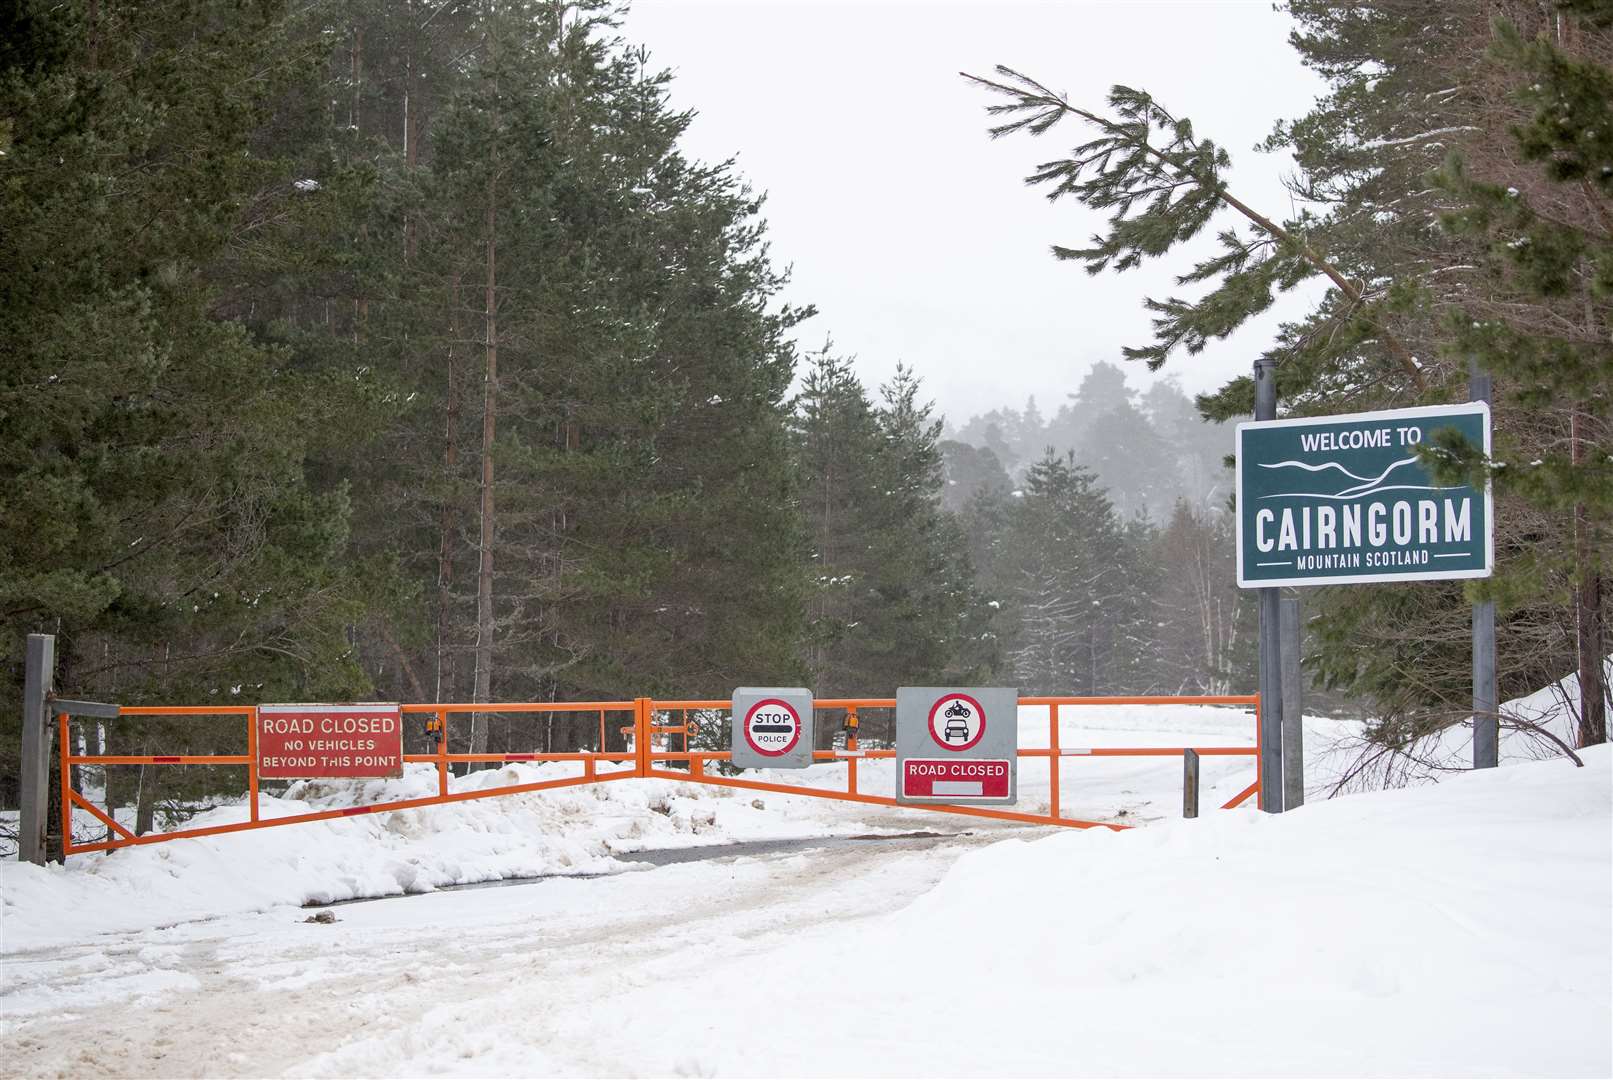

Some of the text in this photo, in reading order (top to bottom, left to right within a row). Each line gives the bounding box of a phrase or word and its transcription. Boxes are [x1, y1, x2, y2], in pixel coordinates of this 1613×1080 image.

[1300, 426, 1422, 452] WELCOME TO
[1256, 497, 1471, 553] CAIRNGORM
[1297, 550, 1429, 571] MOUNTAIN SCOTLAND
[755, 713, 791, 724] STOP
[263, 718, 395, 734] ROAD CLOSED
[284, 739, 375, 751] NO VEHICLES
[758, 735, 787, 743] POLICE
[263, 756, 397, 767] BEYOND THIS POINT
[909, 765, 1004, 776] ROAD CLOSED
